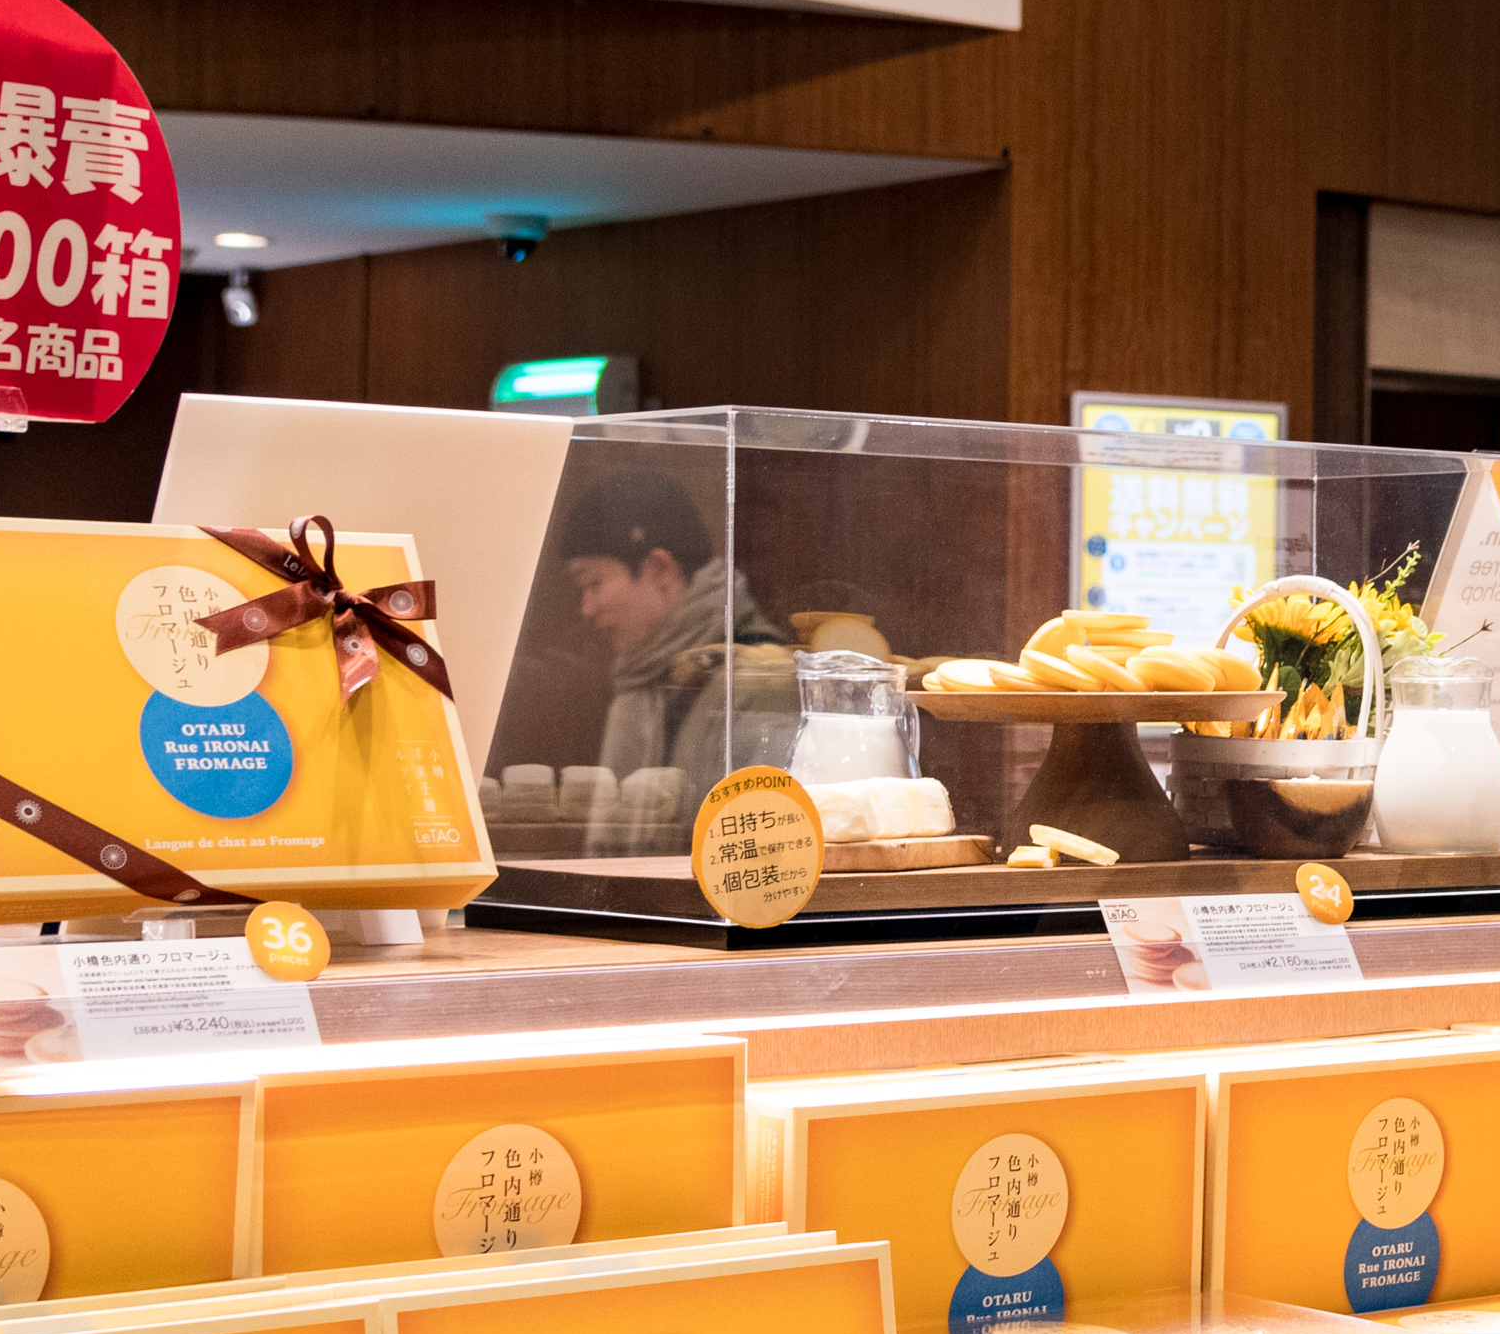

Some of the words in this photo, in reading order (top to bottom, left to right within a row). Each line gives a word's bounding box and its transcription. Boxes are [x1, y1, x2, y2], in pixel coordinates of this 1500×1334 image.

[152, 585, 193, 690] フロマージュ
[181, 723, 246, 739] OTARU
[164, 740, 197, 755] Rue
[202, 739, 270, 755] IRONAI
[174, 755, 268, 771] FROMAGE
[709, 776, 792, 803] おすすめPOINT
[144, 837, 194, 851] Langue
[199, 836, 213, 848] de
[217, 835, 247, 848] chat
[250, 838, 266, 847] au
[269, 834, 326, 849] Fromage
[413, 827, 461, 844] LeTAO
[763, 885, 810, 902] 分けやすい
[1309, 874, 1342, 908] 24
[1248, 902, 1295, 913] フロマージュ
[261, 917, 313, 953] 36
[158, 950, 232, 963] フロマージュ
[269, 951, 310, 967] pieces
[528, 1147, 544, 1187] 小樽
[1376, 1117, 1389, 1216] フロマージュ
[1392, 1116, 1407, 1198] 色内通り
[1026, 1153, 1040, 1188] 小樽
[480, 1149, 497, 1254] フロマージ
[503, 1148, 524, 1248] 色内通り
[1006, 1154, 1023, 1243] 色内通り
[987, 1156, 1002, 1263] フロマージュ
[1371, 1241, 1416, 1258] OTARU
[1357, 1260, 1381, 1275] Rue
[1382, 1255, 1427, 1273] IRONAI
[1361, 1269, 1422, 1288] FROMAGE
[981, 1289, 1034, 1308] OTARU
